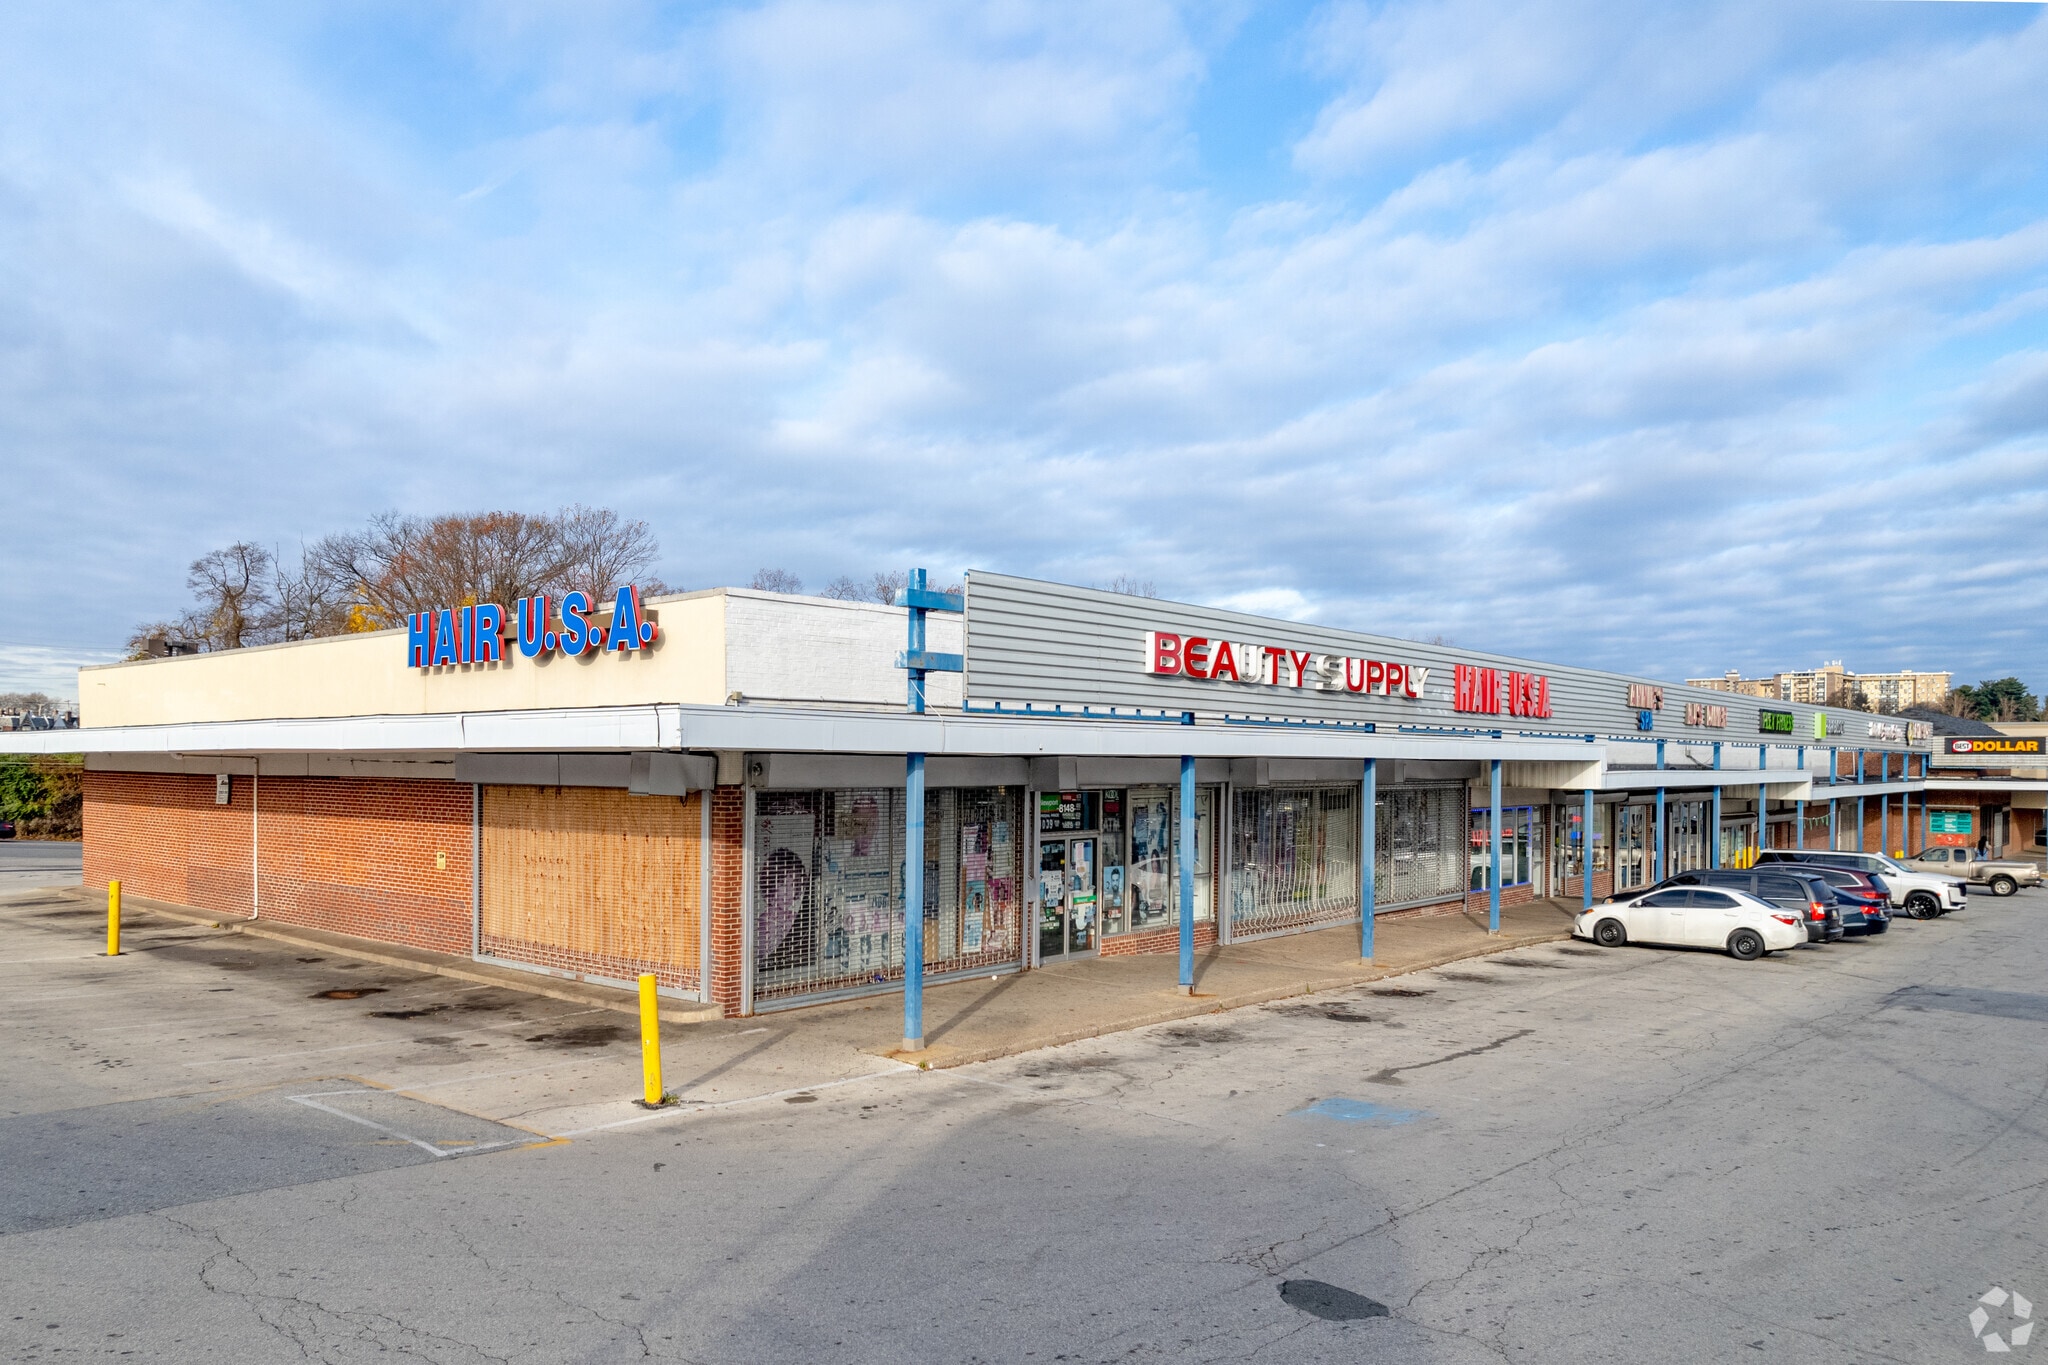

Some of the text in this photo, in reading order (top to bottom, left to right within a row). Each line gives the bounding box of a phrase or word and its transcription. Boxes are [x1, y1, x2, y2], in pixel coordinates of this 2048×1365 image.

[408, 585, 659, 668] HAIR U.S.A.
[1146, 631, 1430, 698] BEAUTY SUPPLY
[1454, 664, 1502, 714] HAIR
[1955, 741, 2039, 752] BEST DOLLAR
